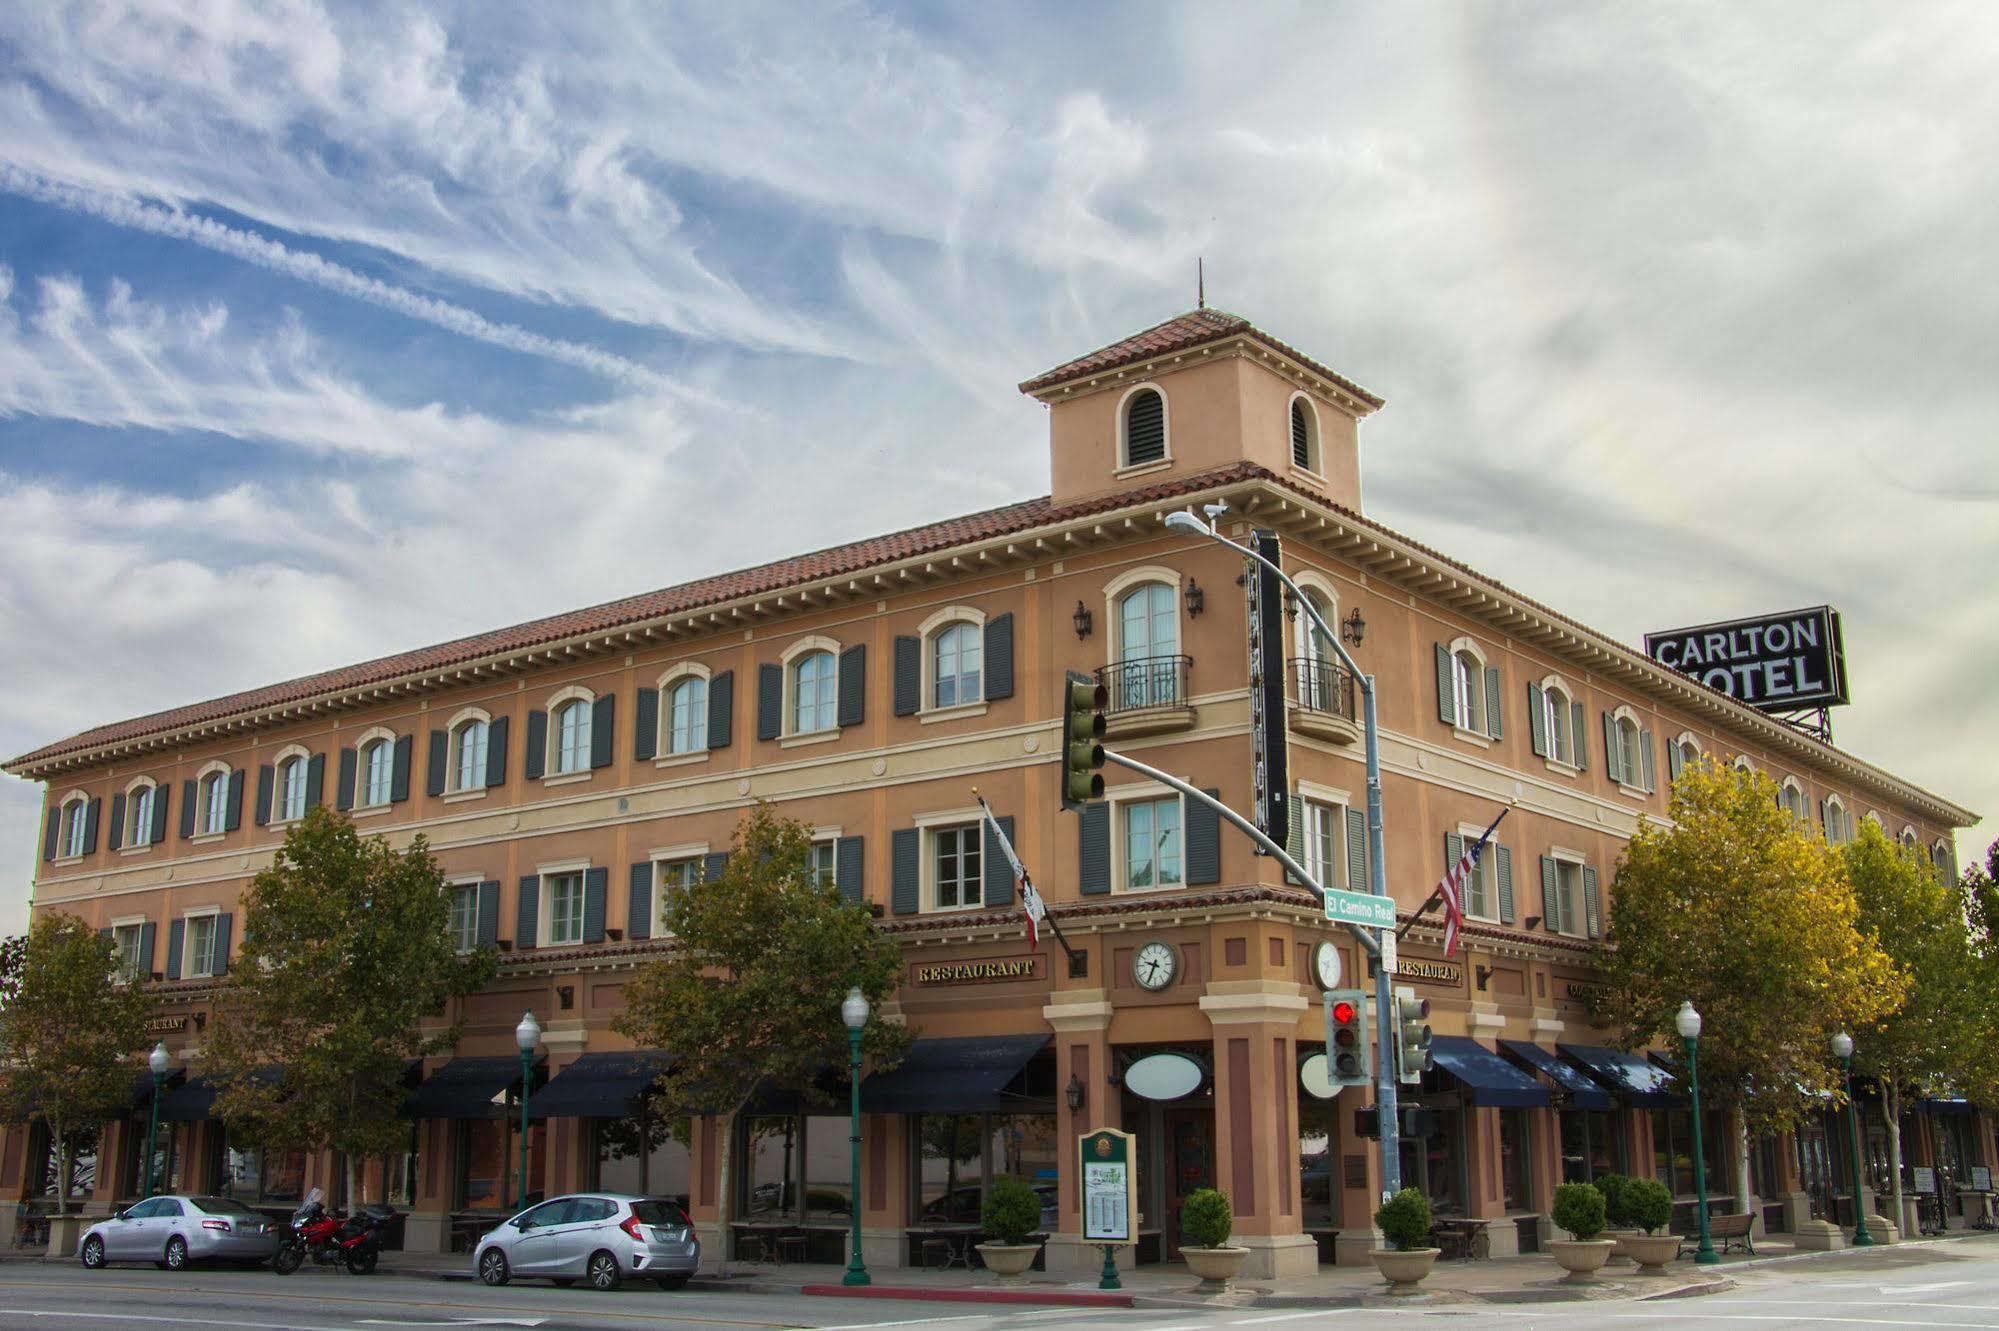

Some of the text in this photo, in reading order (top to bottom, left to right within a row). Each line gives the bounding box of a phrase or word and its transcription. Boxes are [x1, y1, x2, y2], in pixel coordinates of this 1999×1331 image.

[1656, 618, 1820, 668] CARLTON
[1688, 655, 1823, 699] OTEL
[1328, 896, 1394, 921] El Camino Real
[919, 960, 1033, 982] RESTAURANT
[1398, 961, 1462, 981] RESTAURANT
